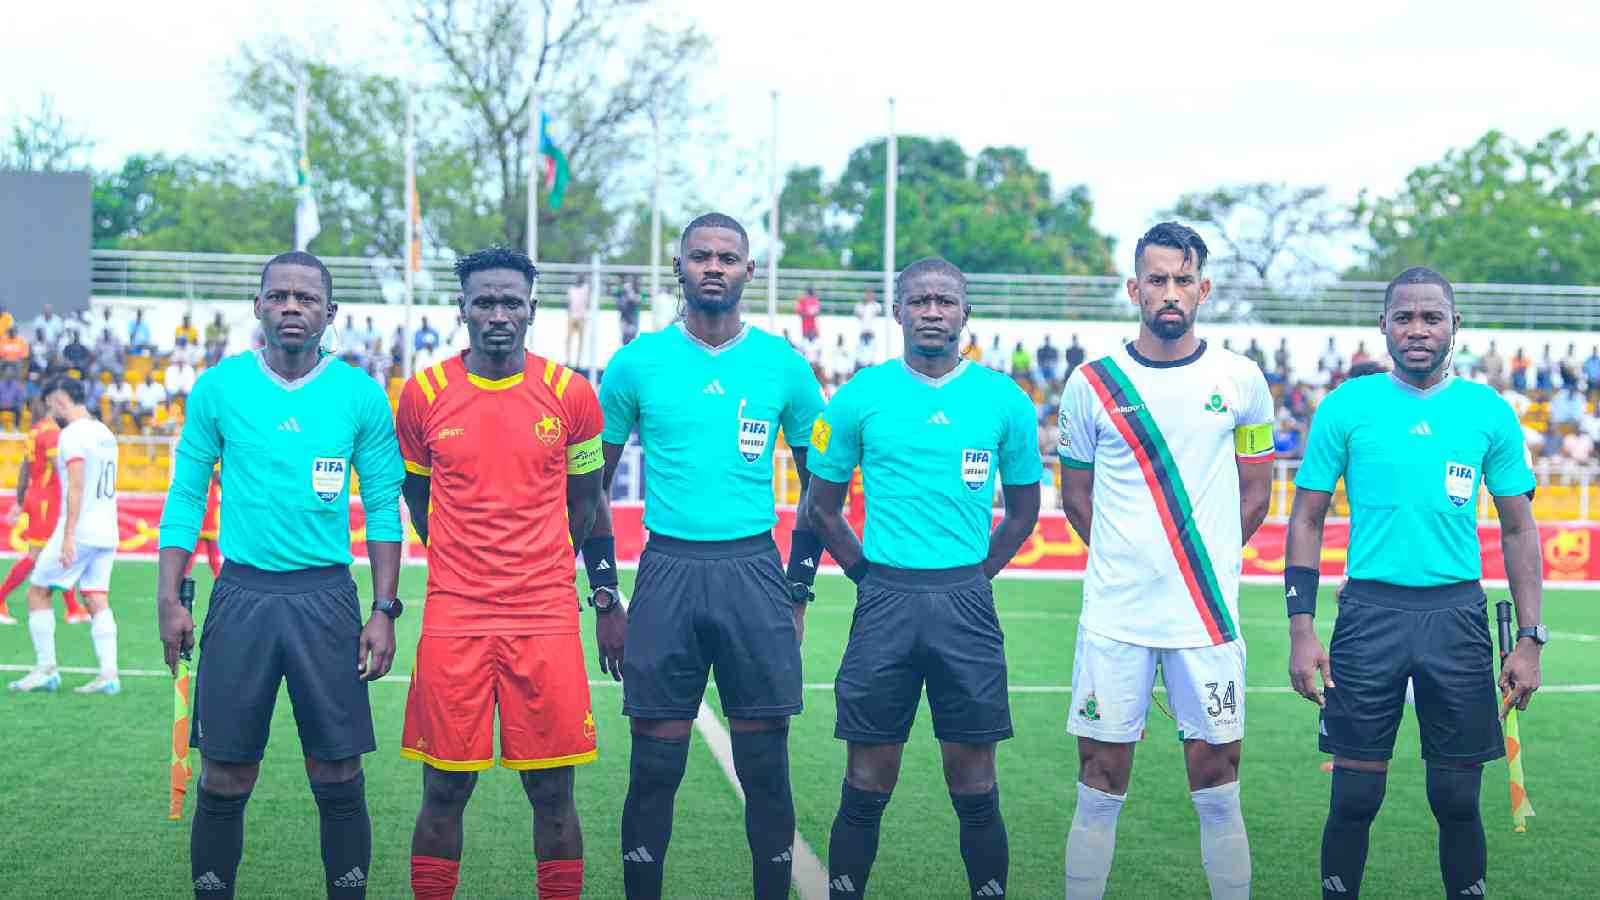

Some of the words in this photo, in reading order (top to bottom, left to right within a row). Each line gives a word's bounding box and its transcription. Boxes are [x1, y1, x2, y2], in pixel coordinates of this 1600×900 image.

[742, 421, 767, 434] FIFA
[965, 451, 989, 463] FIFA
[315, 461, 344, 472] FIFA
[1449, 465, 1472, 480] FIFA
[97, 460, 115, 499] 10
[1204, 680, 1237, 717] 34
